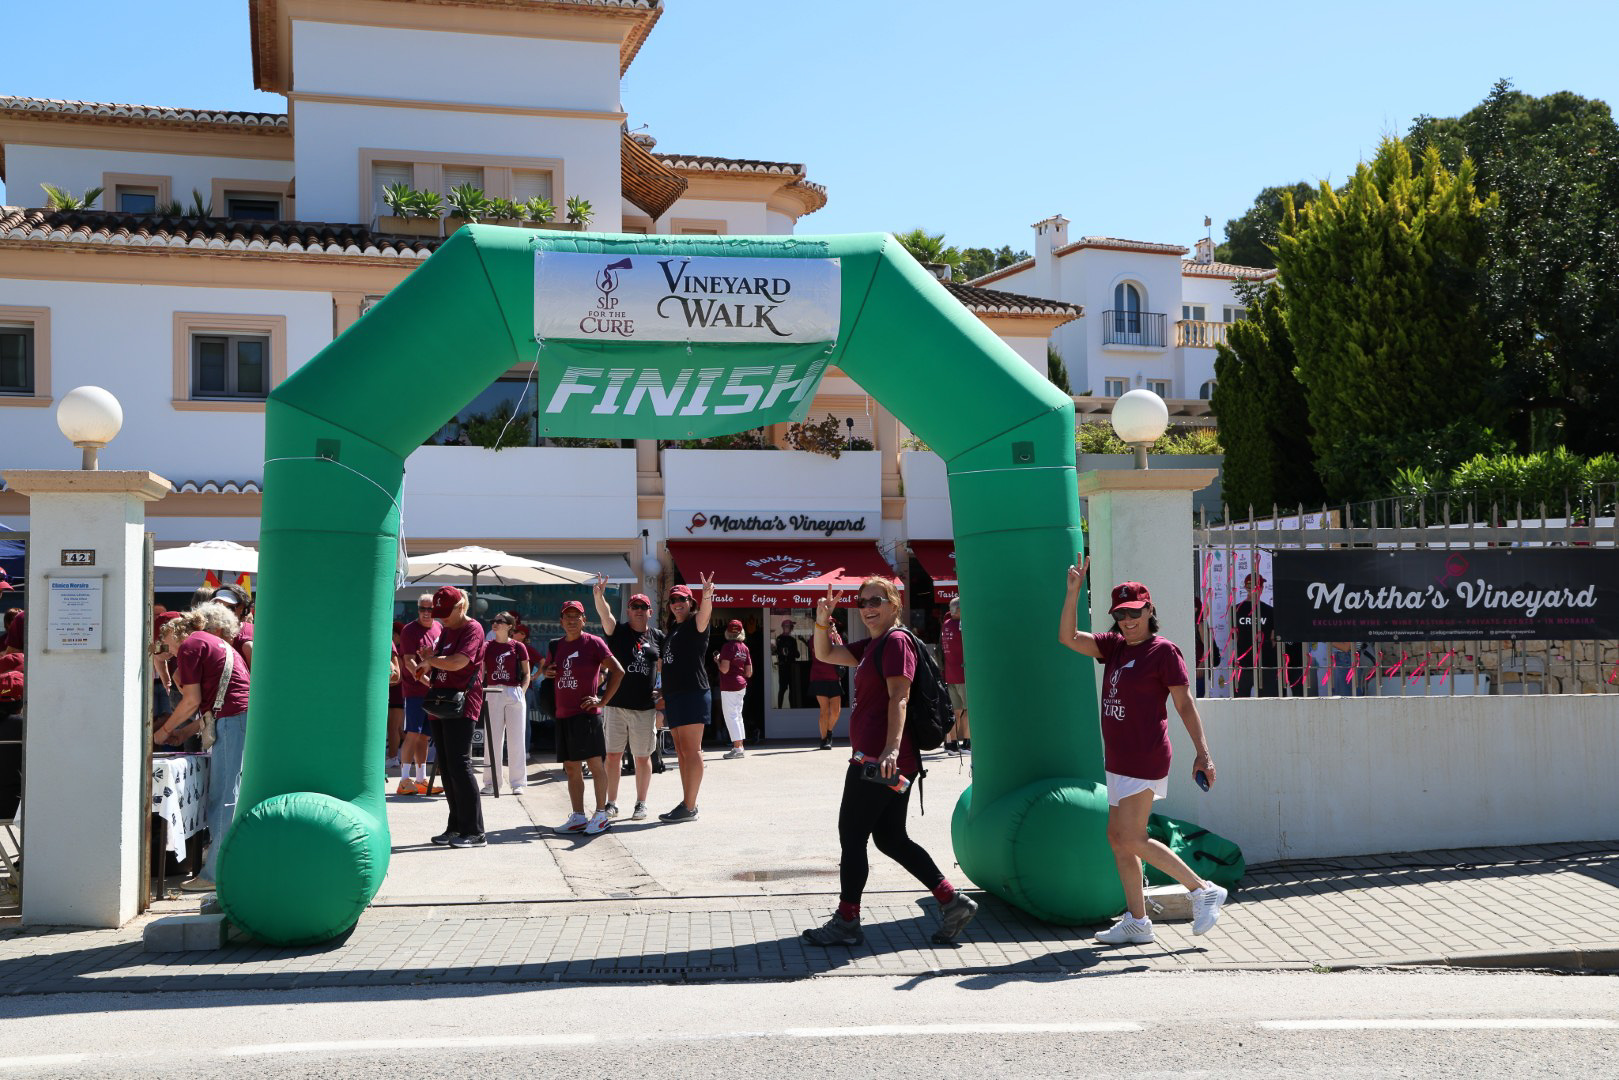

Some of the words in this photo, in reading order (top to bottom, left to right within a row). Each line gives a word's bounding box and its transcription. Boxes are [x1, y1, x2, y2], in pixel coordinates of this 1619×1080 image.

[657, 259, 791, 303] VINEYARD
[657, 295, 793, 336] WALK
[579, 316, 635, 337] CURE
[545, 358, 828, 416] FINISH
[709, 515, 786, 532] Martha's
[789, 514, 866, 536] Vineyard
[70, 553, 86, 562] 42
[711, 593, 734, 603] Taste
[752, 594, 778, 606] Enjoy
[793, 594, 812, 606] Buy
[1306, 581, 1448, 613] Martha's
[1456, 578, 1597, 617] Vineyard
[1238, 617, 1267, 625] CRW
[491, 673, 511, 681] CURE
[627, 664, 651, 676] CURE
[557, 680, 579, 690] CURE
